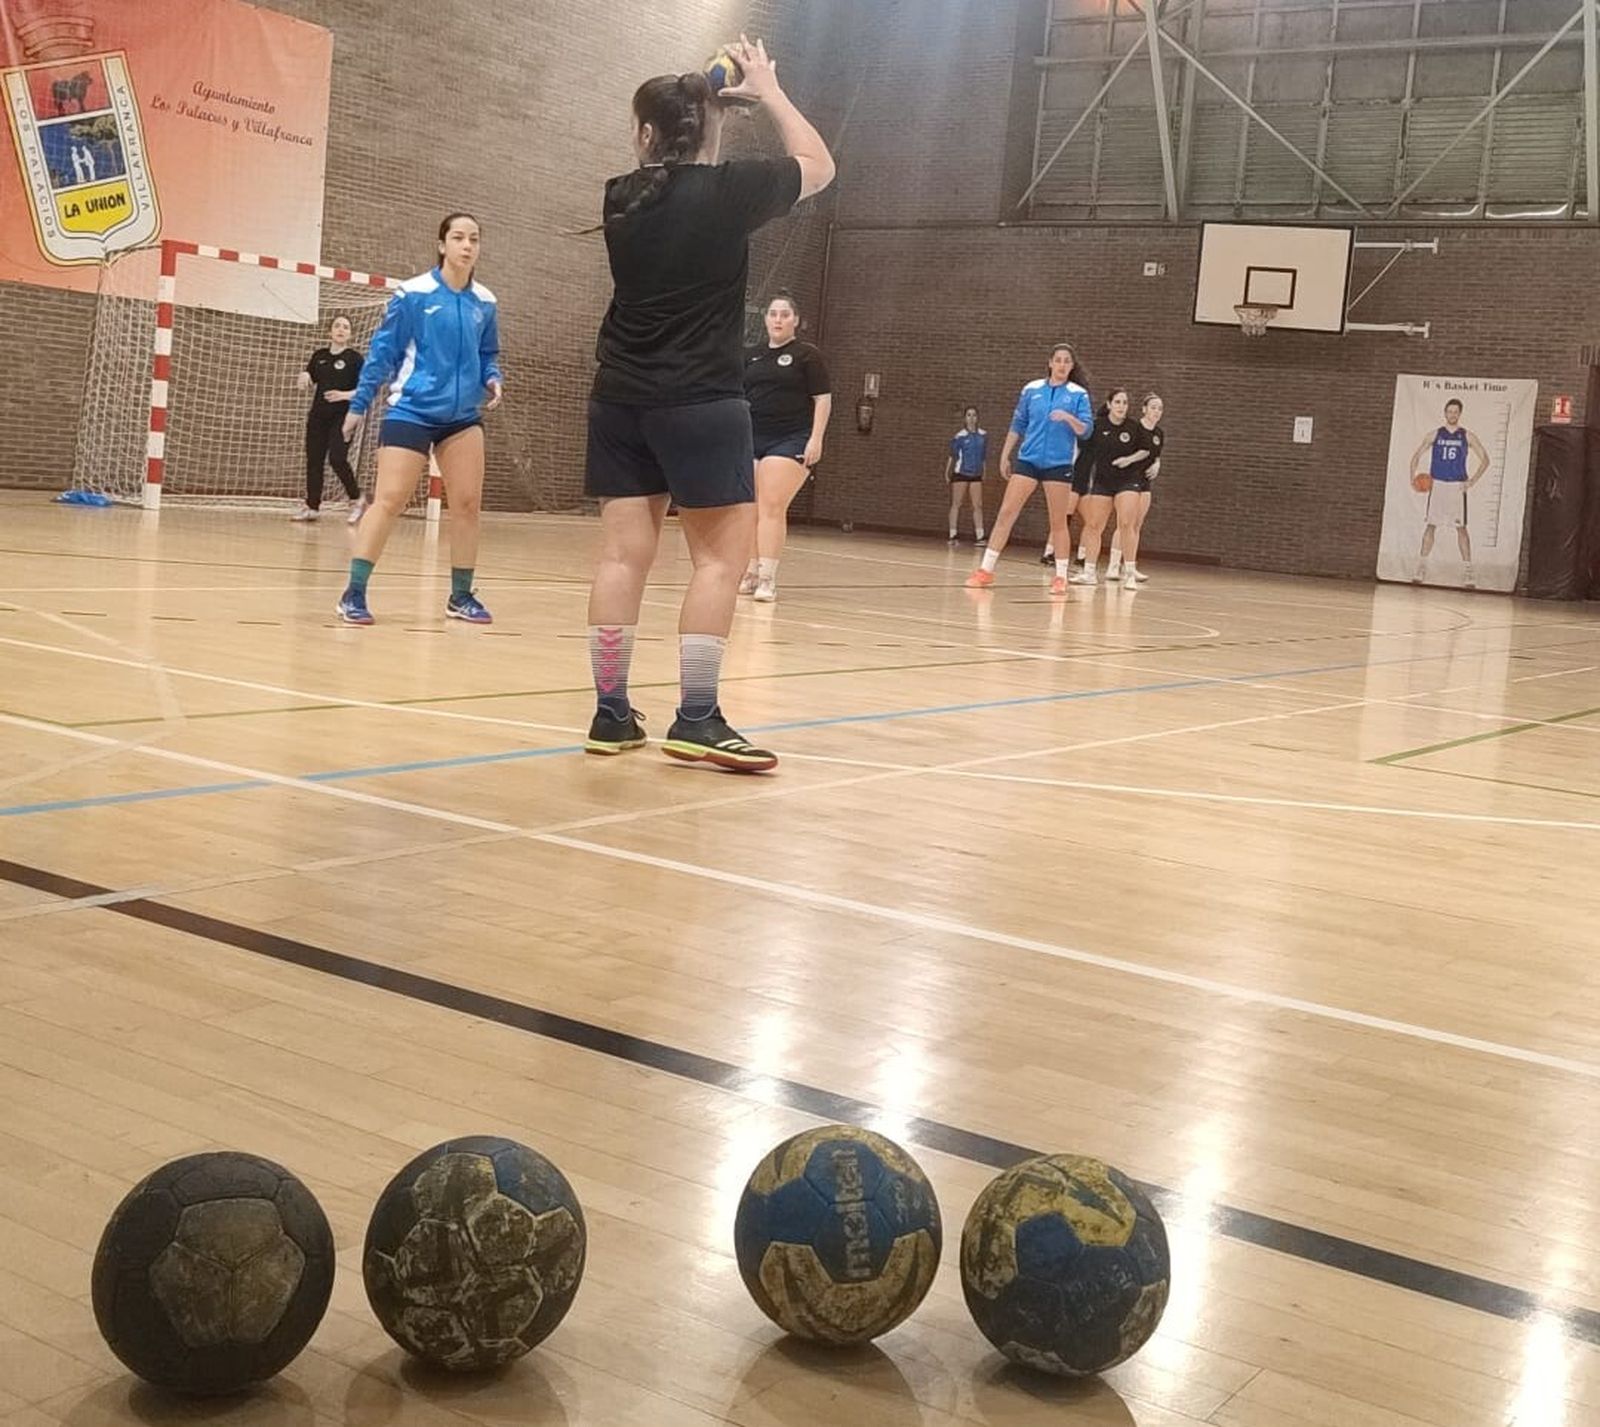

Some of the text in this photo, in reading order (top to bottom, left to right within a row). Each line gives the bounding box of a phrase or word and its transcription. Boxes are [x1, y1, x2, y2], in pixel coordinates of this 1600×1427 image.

[192, 81, 275, 115] Ayuntamiento
[151, 94, 171, 112] Los
[231, 119, 240, 132] y
[243, 119, 313, 146] Villafranca
[116, 86, 150, 211] VILLAFRANCA
[17, 97, 56, 239] LOS PALACIOS
[64, 193, 126, 218] LA UNION
[1444, 381, 1479, 391] Basket
[1483, 382, 1508, 392] Time
[1442, 447, 1457, 460] 16
